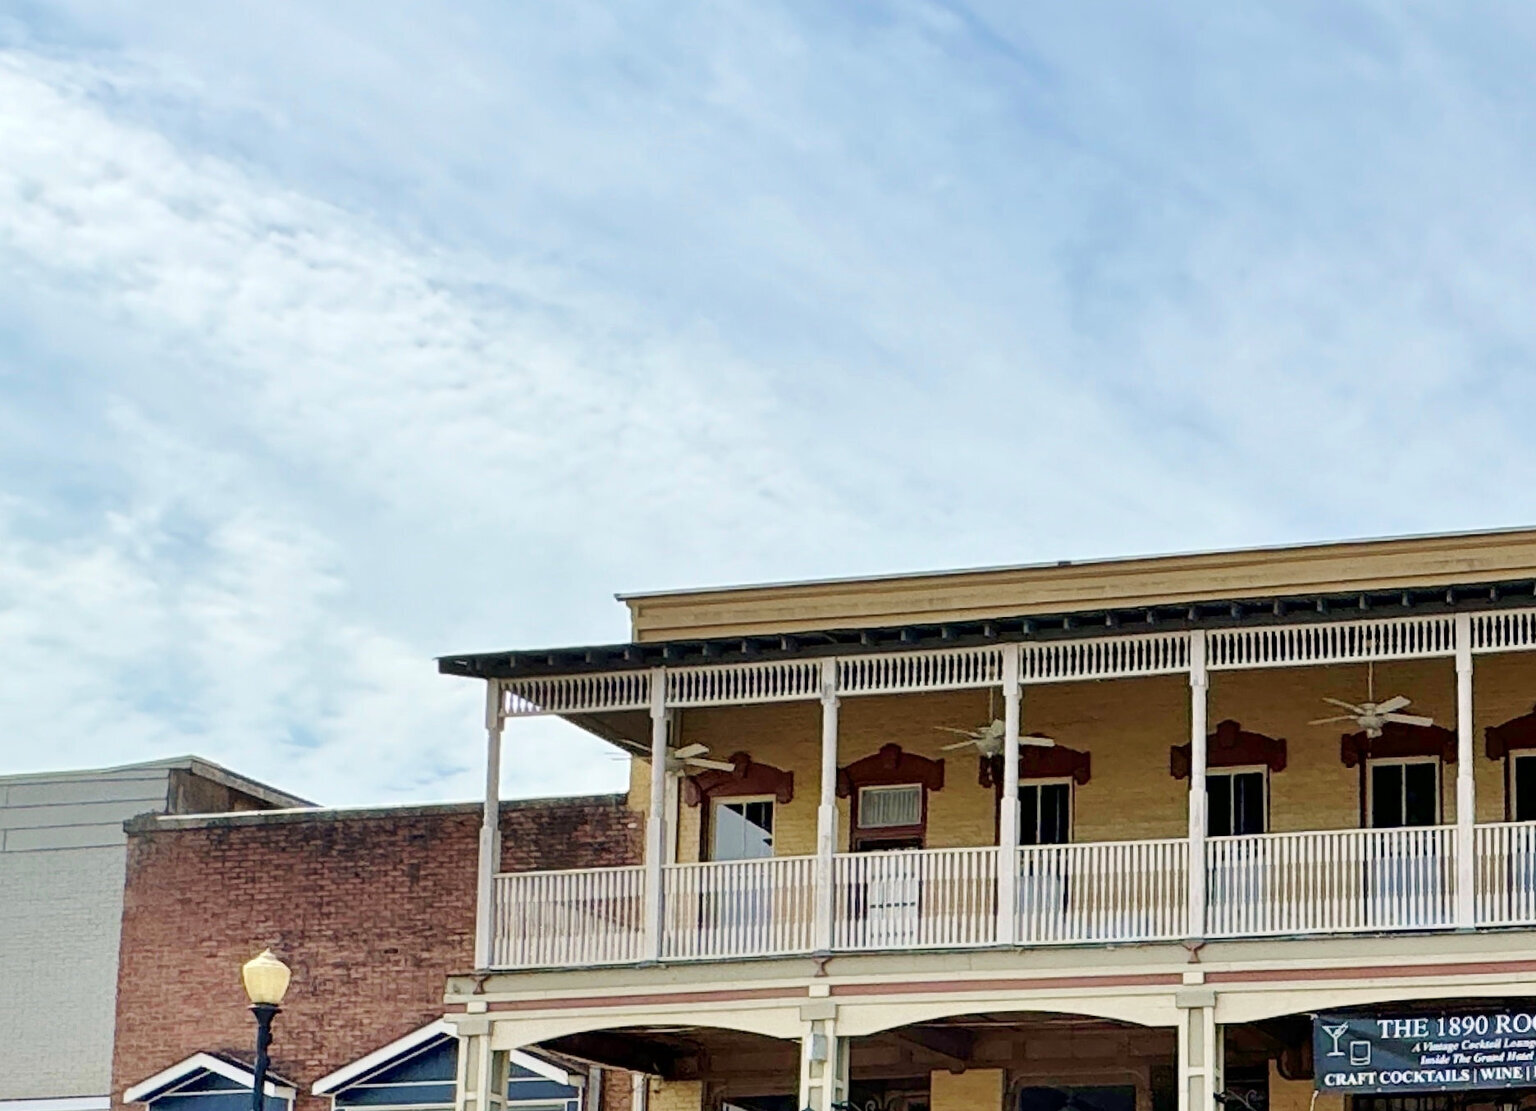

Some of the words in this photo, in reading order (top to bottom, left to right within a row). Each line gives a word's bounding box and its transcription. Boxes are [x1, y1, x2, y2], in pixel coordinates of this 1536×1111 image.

[1377, 1018, 1429, 1039] THE
[1437, 1015, 1489, 1036] 1890
[1411, 1044, 1421, 1053] A
[1423, 1042, 1459, 1054] Vintage
[1462, 1038, 1501, 1050] Cocktail
[1420, 1055, 1450, 1065] Inside
[1453, 1053, 1472, 1064] The
[1474, 1052, 1505, 1063] Grand
[1507, 1051, 1535, 1061] Hotel
[1324, 1071, 1377, 1086] CRAFT
[1379, 1069, 1470, 1084] COCKTAILS
[1480, 1066, 1523, 1081] WINE
